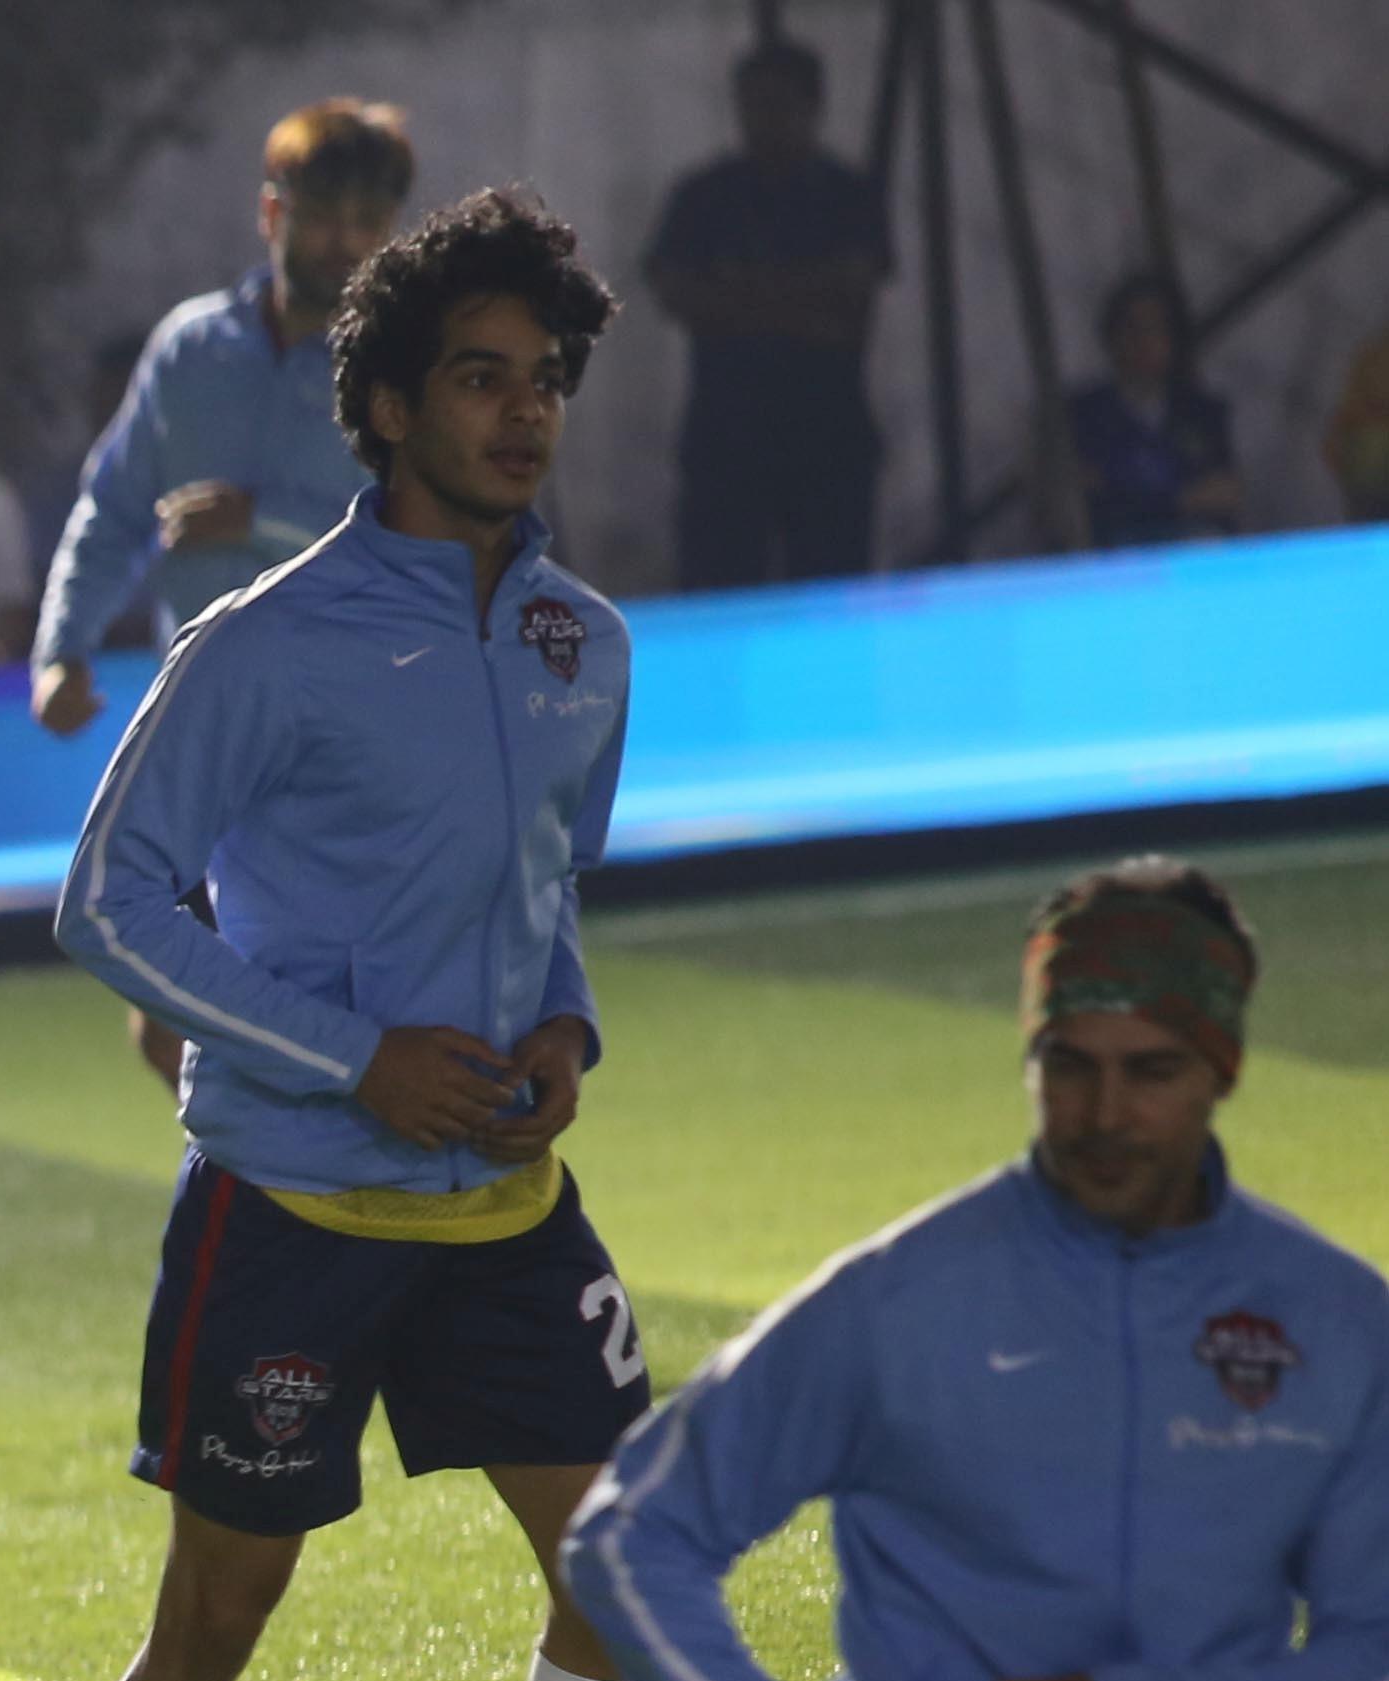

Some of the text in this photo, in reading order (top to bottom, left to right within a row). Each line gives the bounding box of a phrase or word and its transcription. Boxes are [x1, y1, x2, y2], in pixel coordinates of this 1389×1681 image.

[579, 1272, 645, 1389] 2
[262, 1367, 319, 1387] ALL
[241, 1381, 329, 1401] STARS
